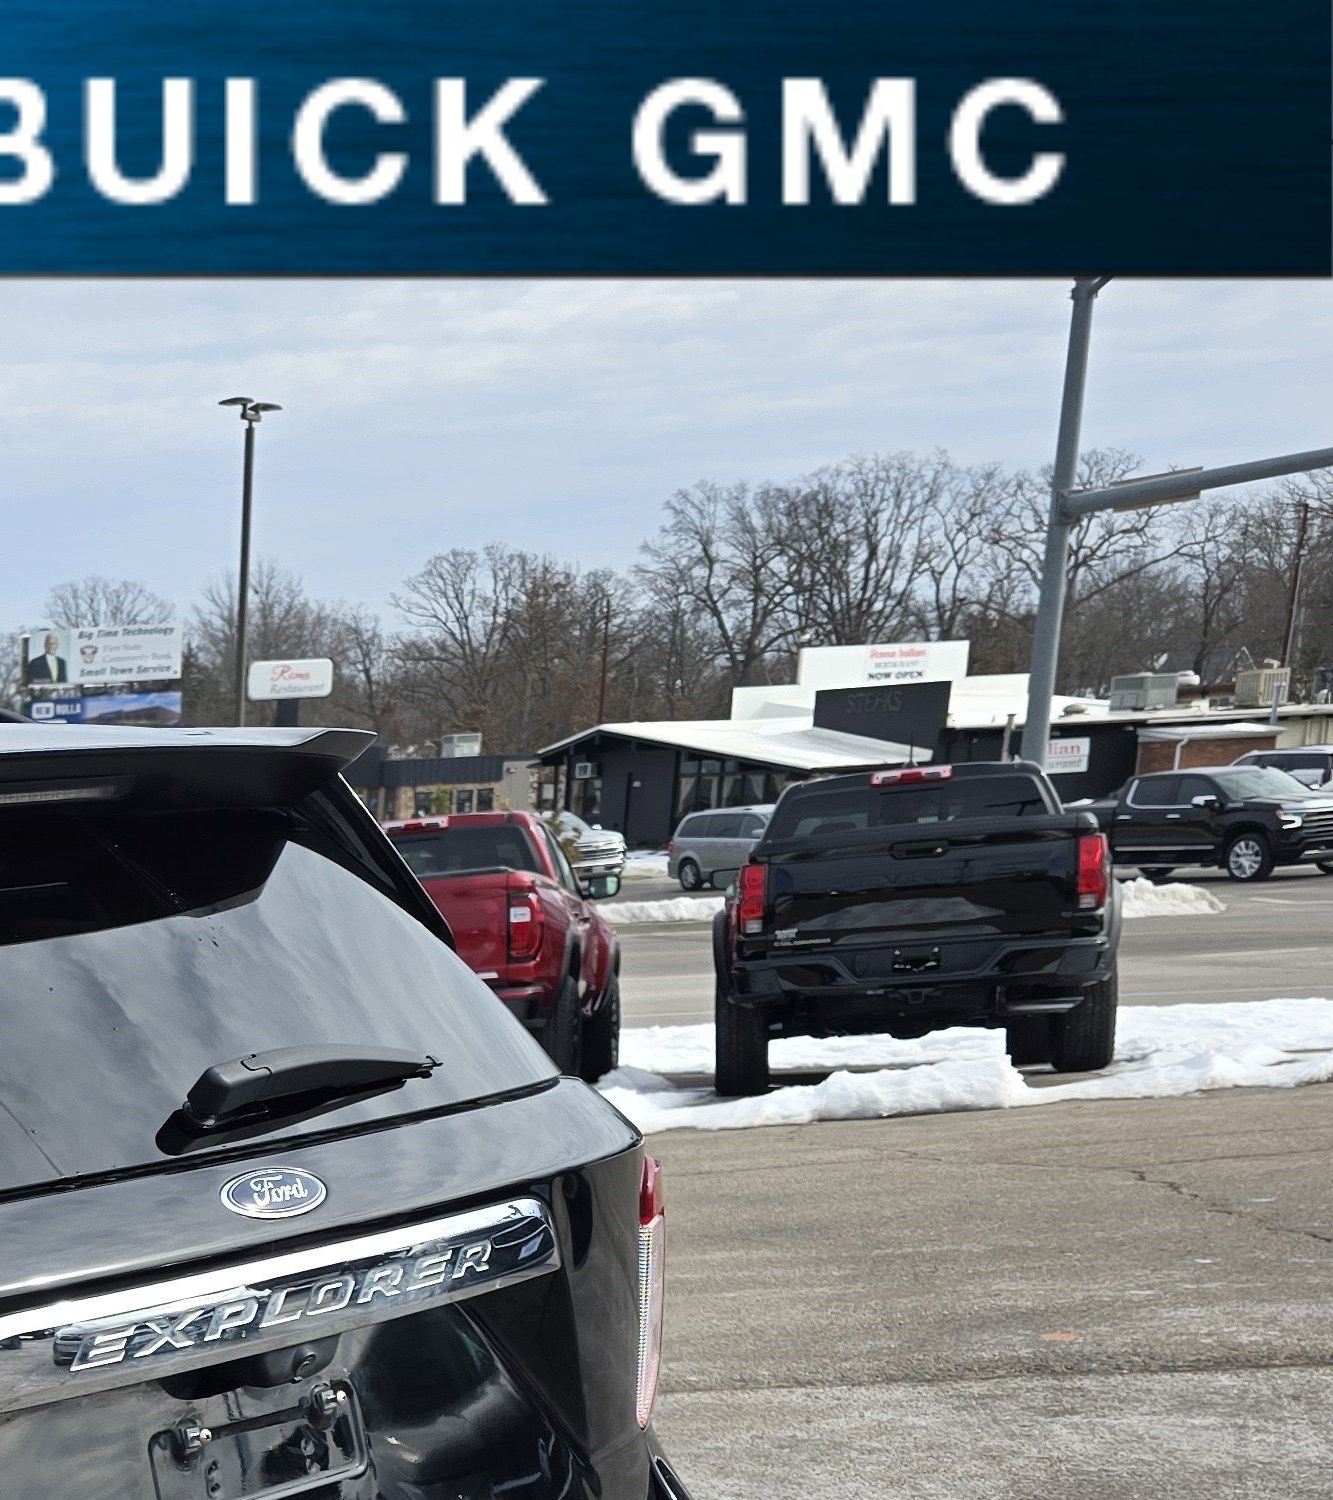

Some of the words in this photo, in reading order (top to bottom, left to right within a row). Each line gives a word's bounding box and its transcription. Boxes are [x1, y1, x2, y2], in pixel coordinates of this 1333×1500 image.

[78, 631, 94, 641] Big
[97, 629, 119, 638] Time
[122, 627, 175, 637] Technology
[868, 671, 892, 680] NOW
[895, 670, 923, 680] OPEN
[845, 690, 903, 714] STEAKS
[249, 1174, 309, 1208] Ford
[69, 1238, 493, 1373] EXPLORER
